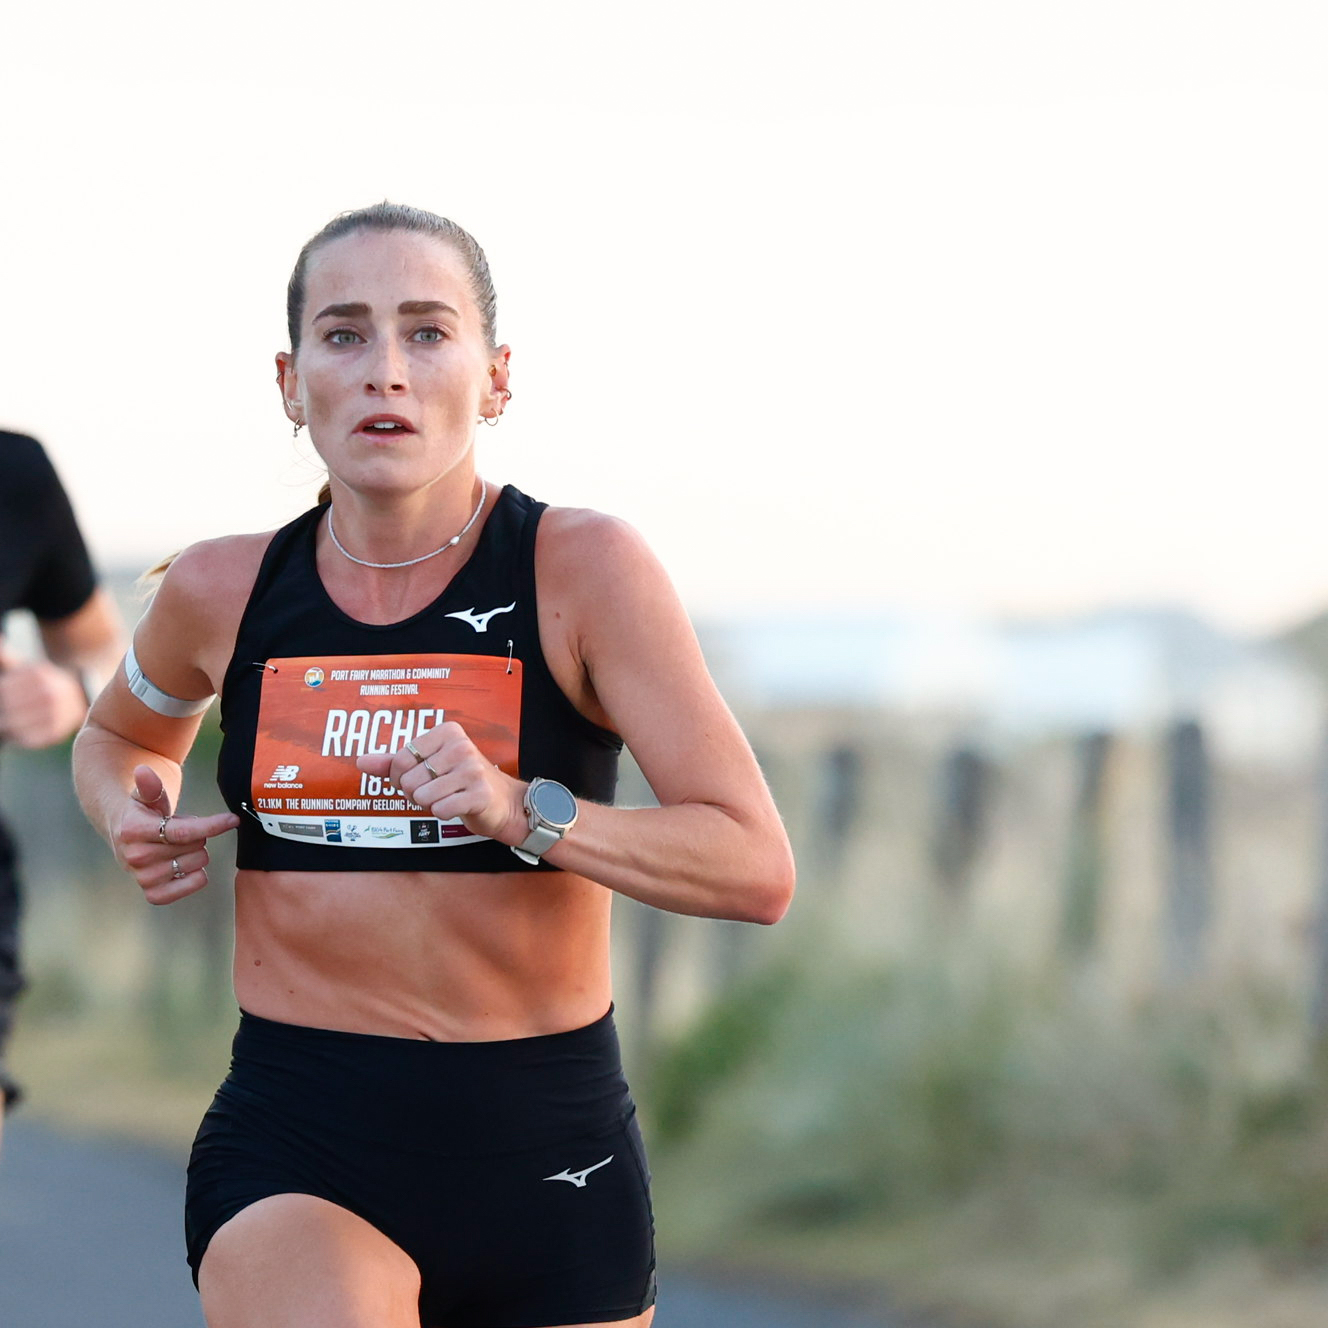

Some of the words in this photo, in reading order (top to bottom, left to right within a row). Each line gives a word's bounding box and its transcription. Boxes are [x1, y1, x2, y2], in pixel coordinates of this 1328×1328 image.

[330, 670, 349, 681] PORT
[349, 669, 370, 681] FAIRY
[370, 669, 406, 680] MARATHON
[360, 685, 390, 696] RUNNING
[390, 684, 419, 695] FESTIVAL
[257, 798, 282, 809] 21.1KM
[285, 798, 300, 810] THE
[301, 798, 334, 810] RUNNING
[335, 799, 371, 811] COMPANY
[373, 799, 405, 811] GEELONG
